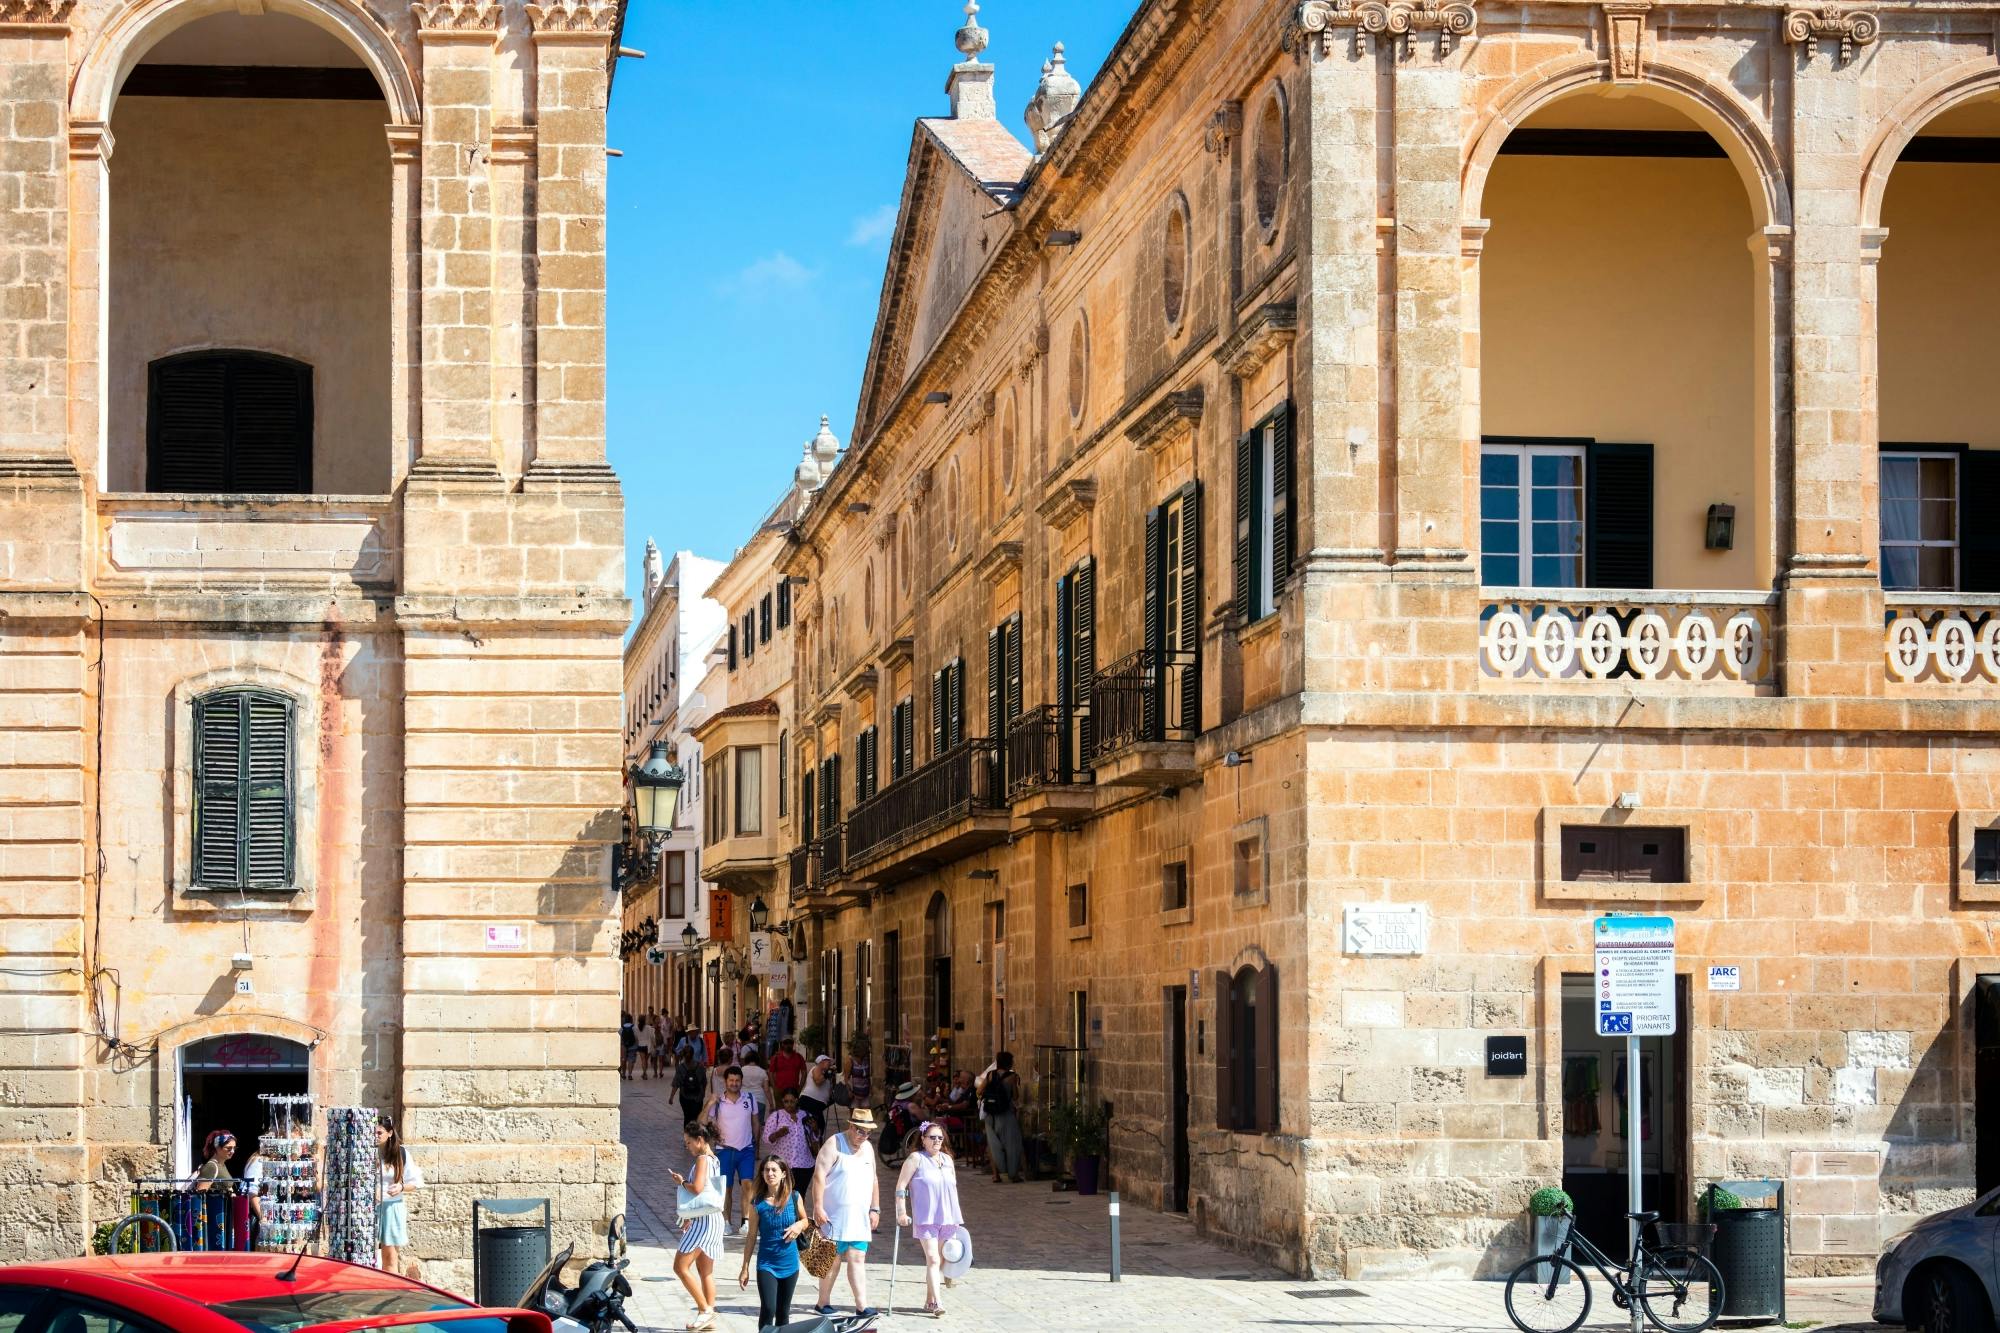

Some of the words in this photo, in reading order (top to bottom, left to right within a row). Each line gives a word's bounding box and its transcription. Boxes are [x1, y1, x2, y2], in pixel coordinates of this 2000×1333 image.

[714, 894, 728, 928] MITIK
[1710, 967, 1737, 976] JARC
[239, 981, 249, 991] 31
[1637, 1022, 1671, 1030] VIANANTS
[743, 1101, 749, 1109] 3
